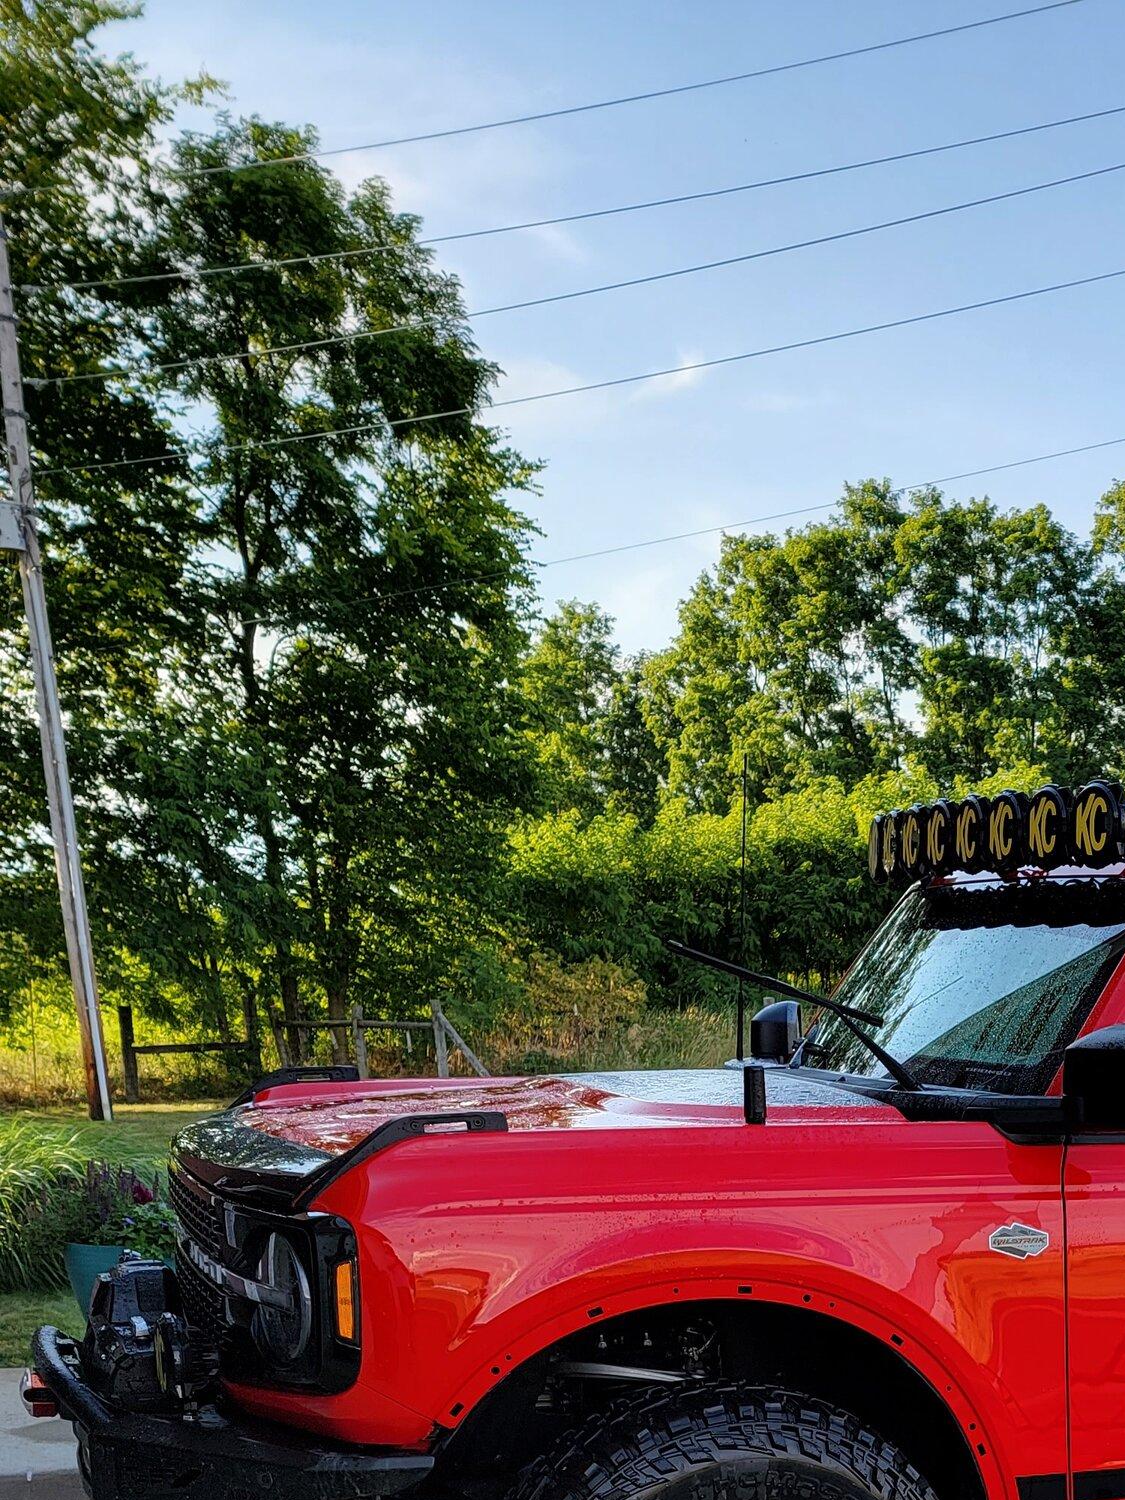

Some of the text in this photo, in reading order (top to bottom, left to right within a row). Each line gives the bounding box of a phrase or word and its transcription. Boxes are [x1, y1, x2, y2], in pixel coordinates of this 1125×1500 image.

[903, 814, 918, 868] KC
[926, 809, 945, 865] KC
[956, 805, 976, 862] KC
[989, 801, 1013, 860] KC
[1029, 796, 1057, 858] KC
[1075, 793, 1107, 856] KC
